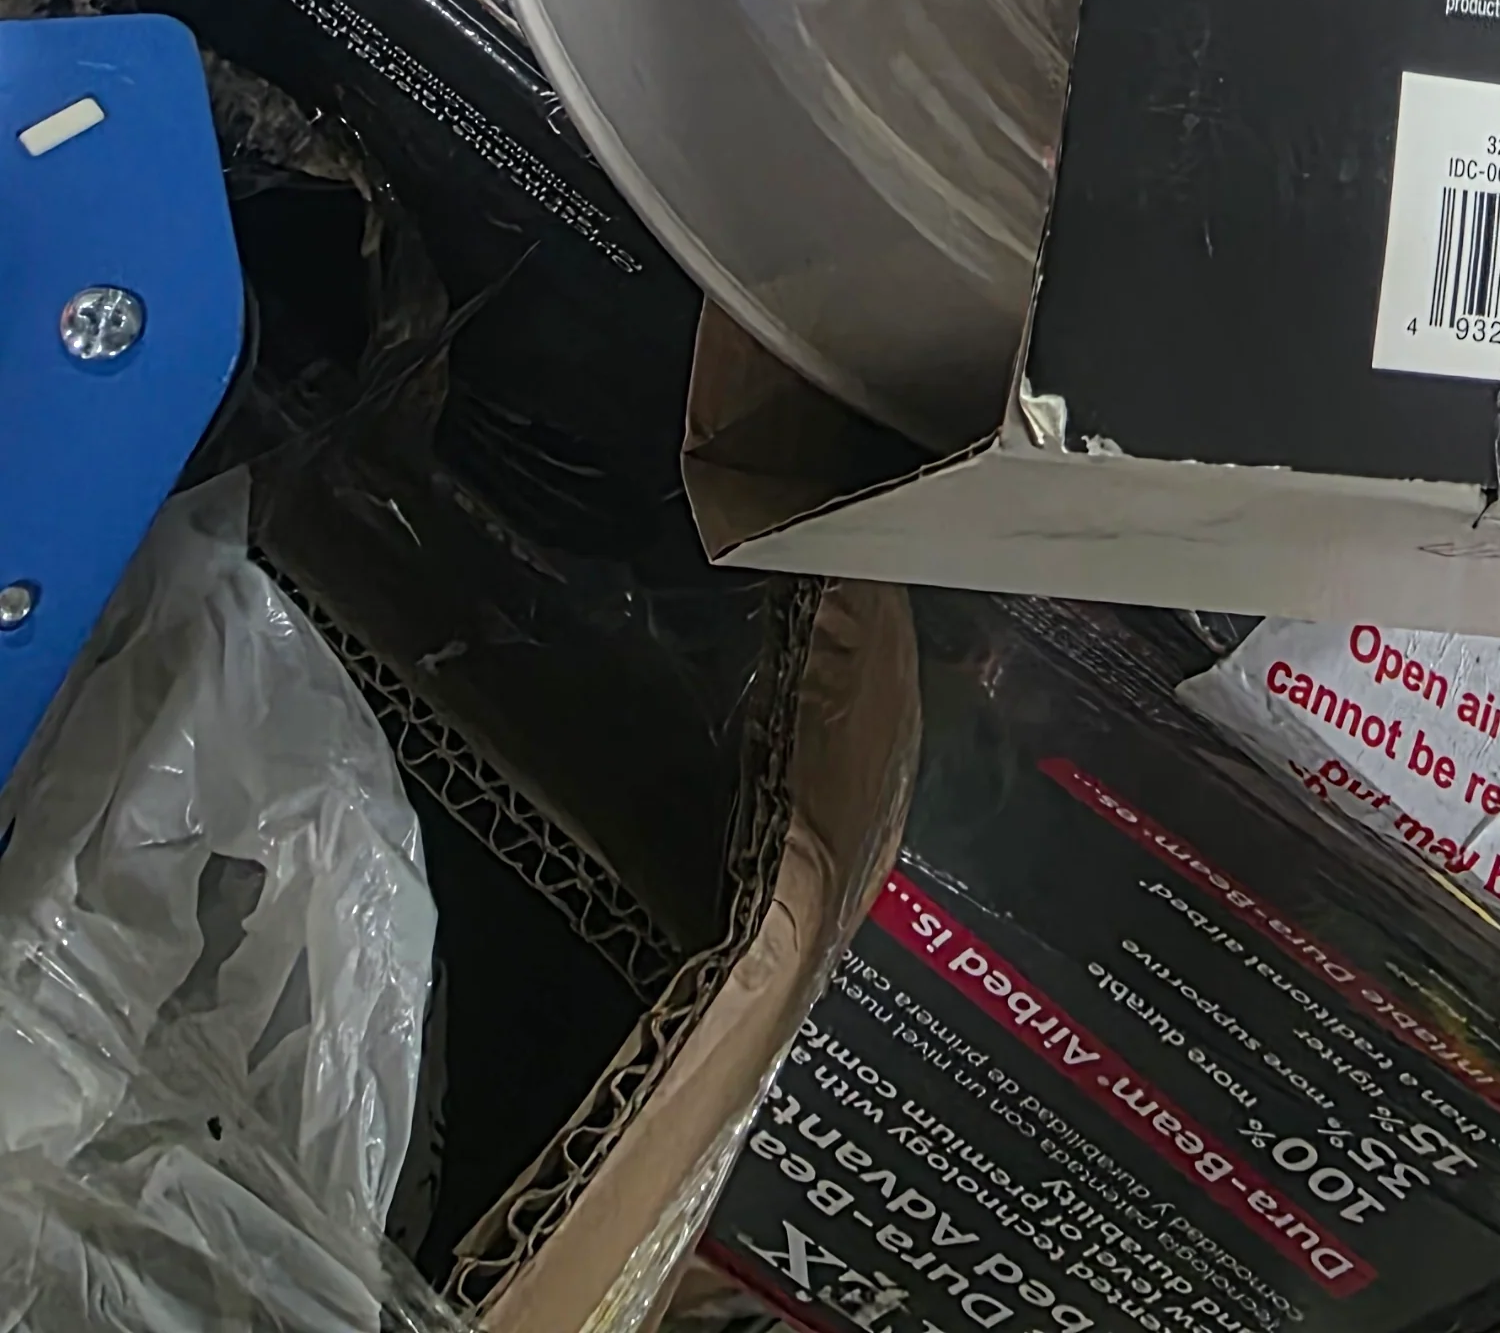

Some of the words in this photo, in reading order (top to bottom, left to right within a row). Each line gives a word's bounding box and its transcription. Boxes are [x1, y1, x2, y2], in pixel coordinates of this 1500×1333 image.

[1406, 317, 1418, 336] 4
[1349, 624, 1449, 710] Open
[1267, 659, 1402, 760] cannot
[1409, 731, 1456, 789] be
[1395, 813, 1479, 875] may
[948, 947, 1101, 1068] Airbed
[1087, 961, 1186, 1047] durable
[1121, 938, 1262, 1052] supportive
[1244, 955, 1393, 1070] traditional
[814, 1064, 886, 1125] with
[1188, 1047, 1260, 1110] more
[1263, 1052, 1335, 1110] more
[1293, 1028, 1385, 1099] lighter
[887, 1126, 1067, 1261] technology
[901, 1099, 1049, 1213] premium
